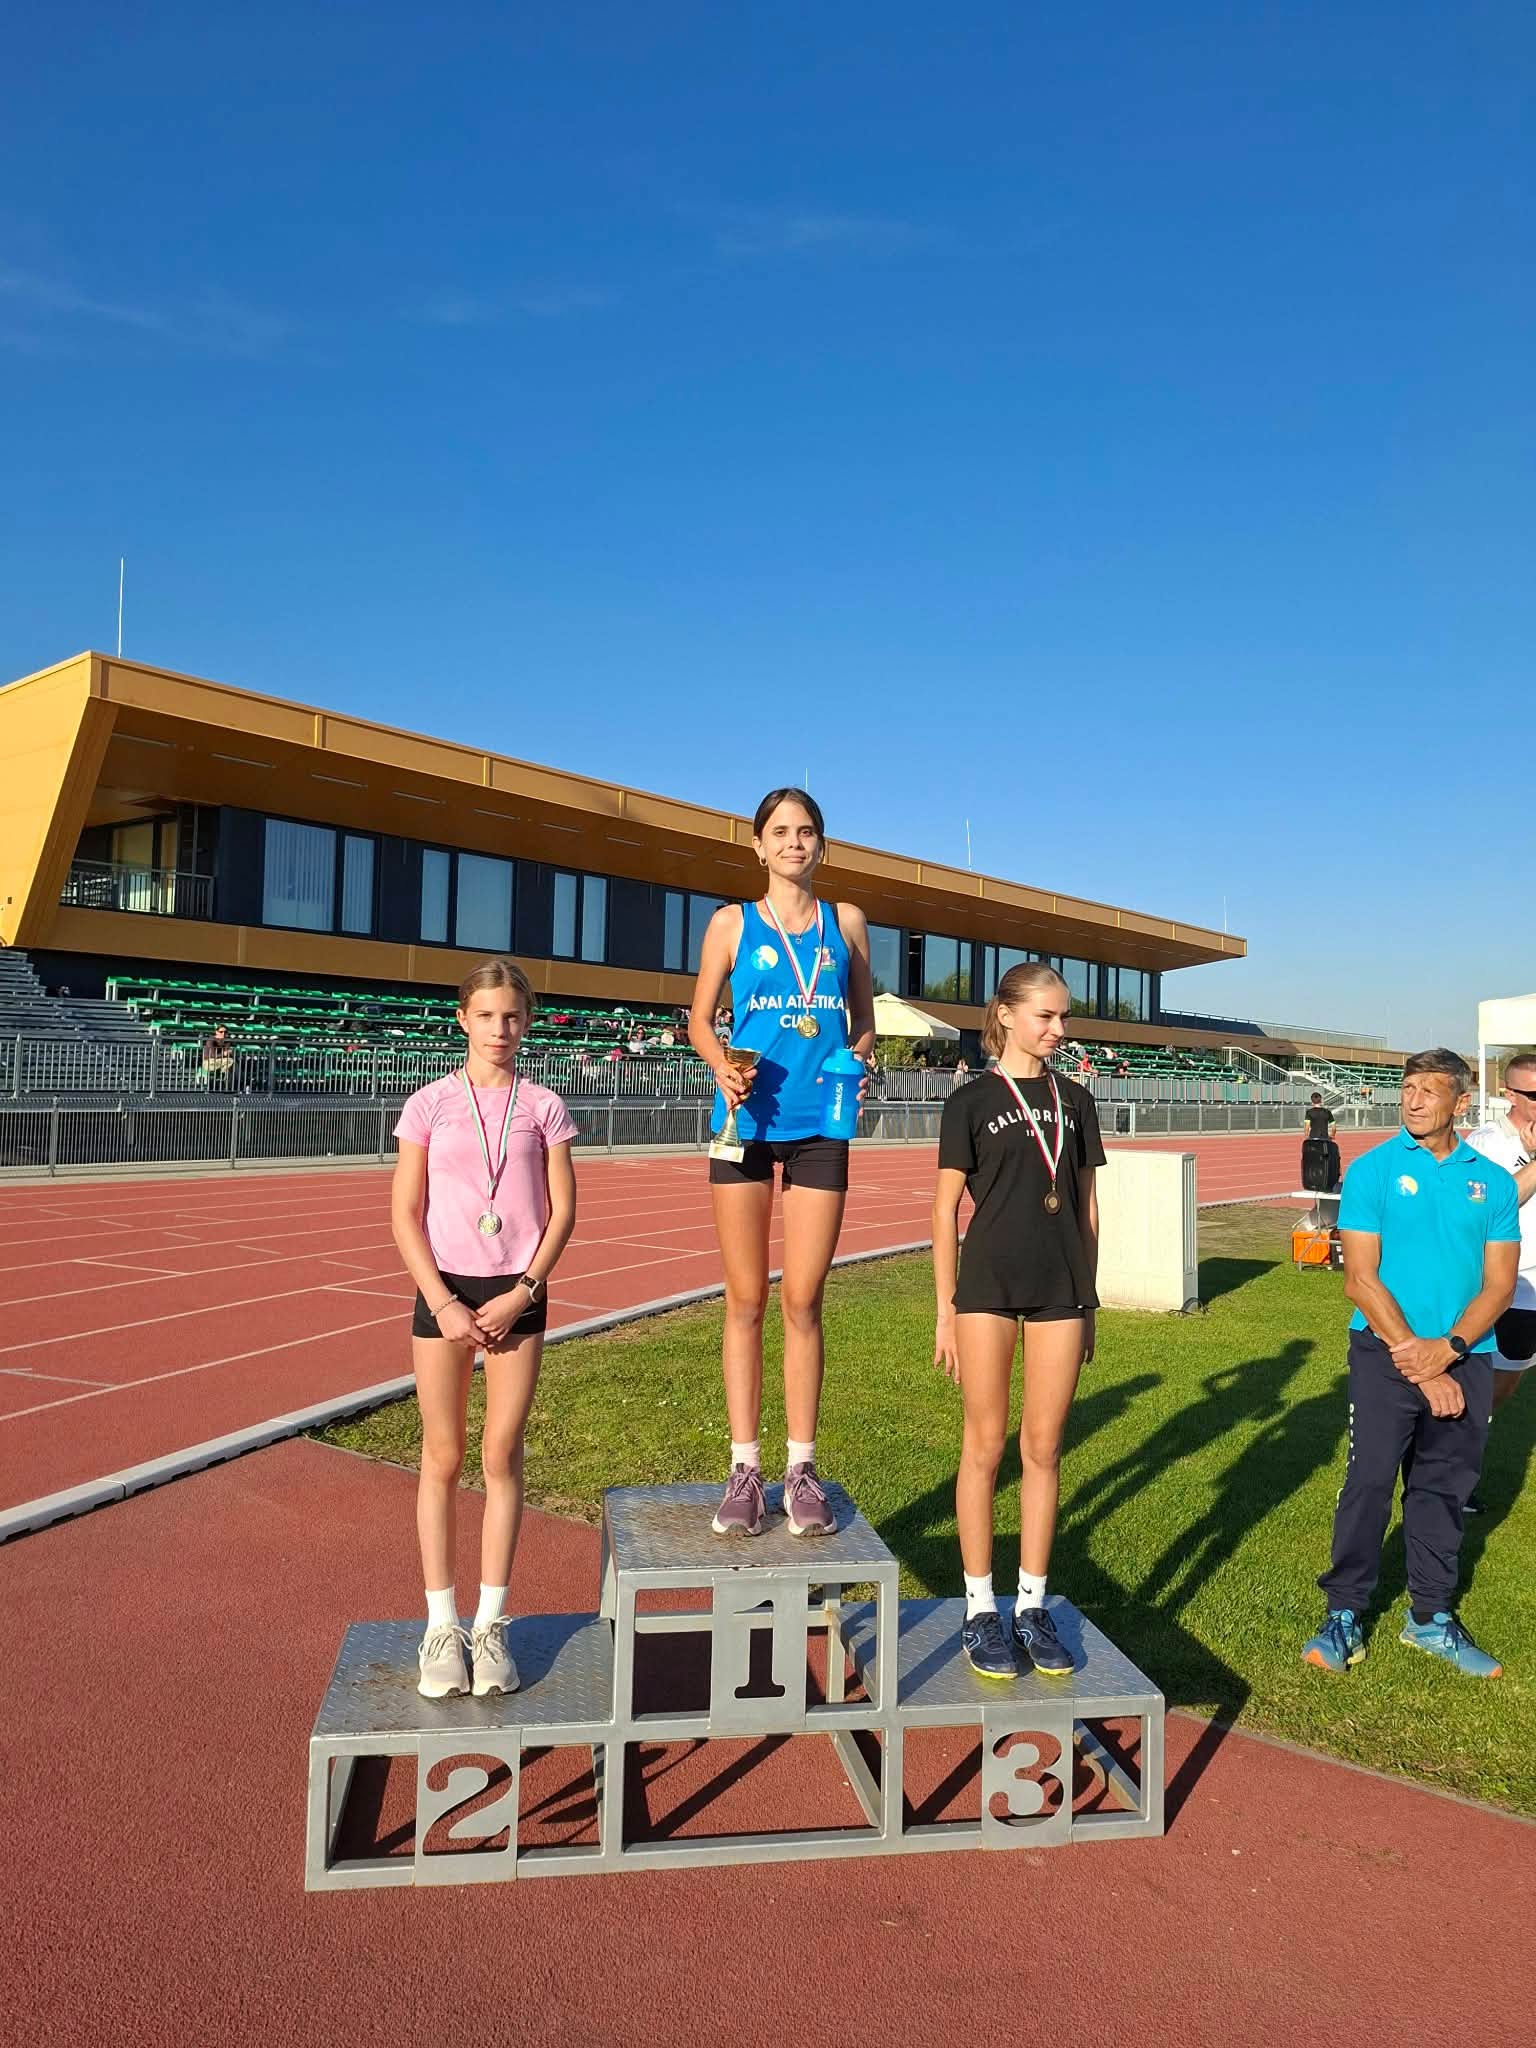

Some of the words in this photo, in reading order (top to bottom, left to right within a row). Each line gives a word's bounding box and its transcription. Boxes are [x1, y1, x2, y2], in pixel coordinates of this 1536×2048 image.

[745, 993, 783, 1012] ÁPAI
[733, 1599, 786, 1699] 1
[422, 1753, 513, 1856] 2
[988, 1730, 1064, 1827] 3
